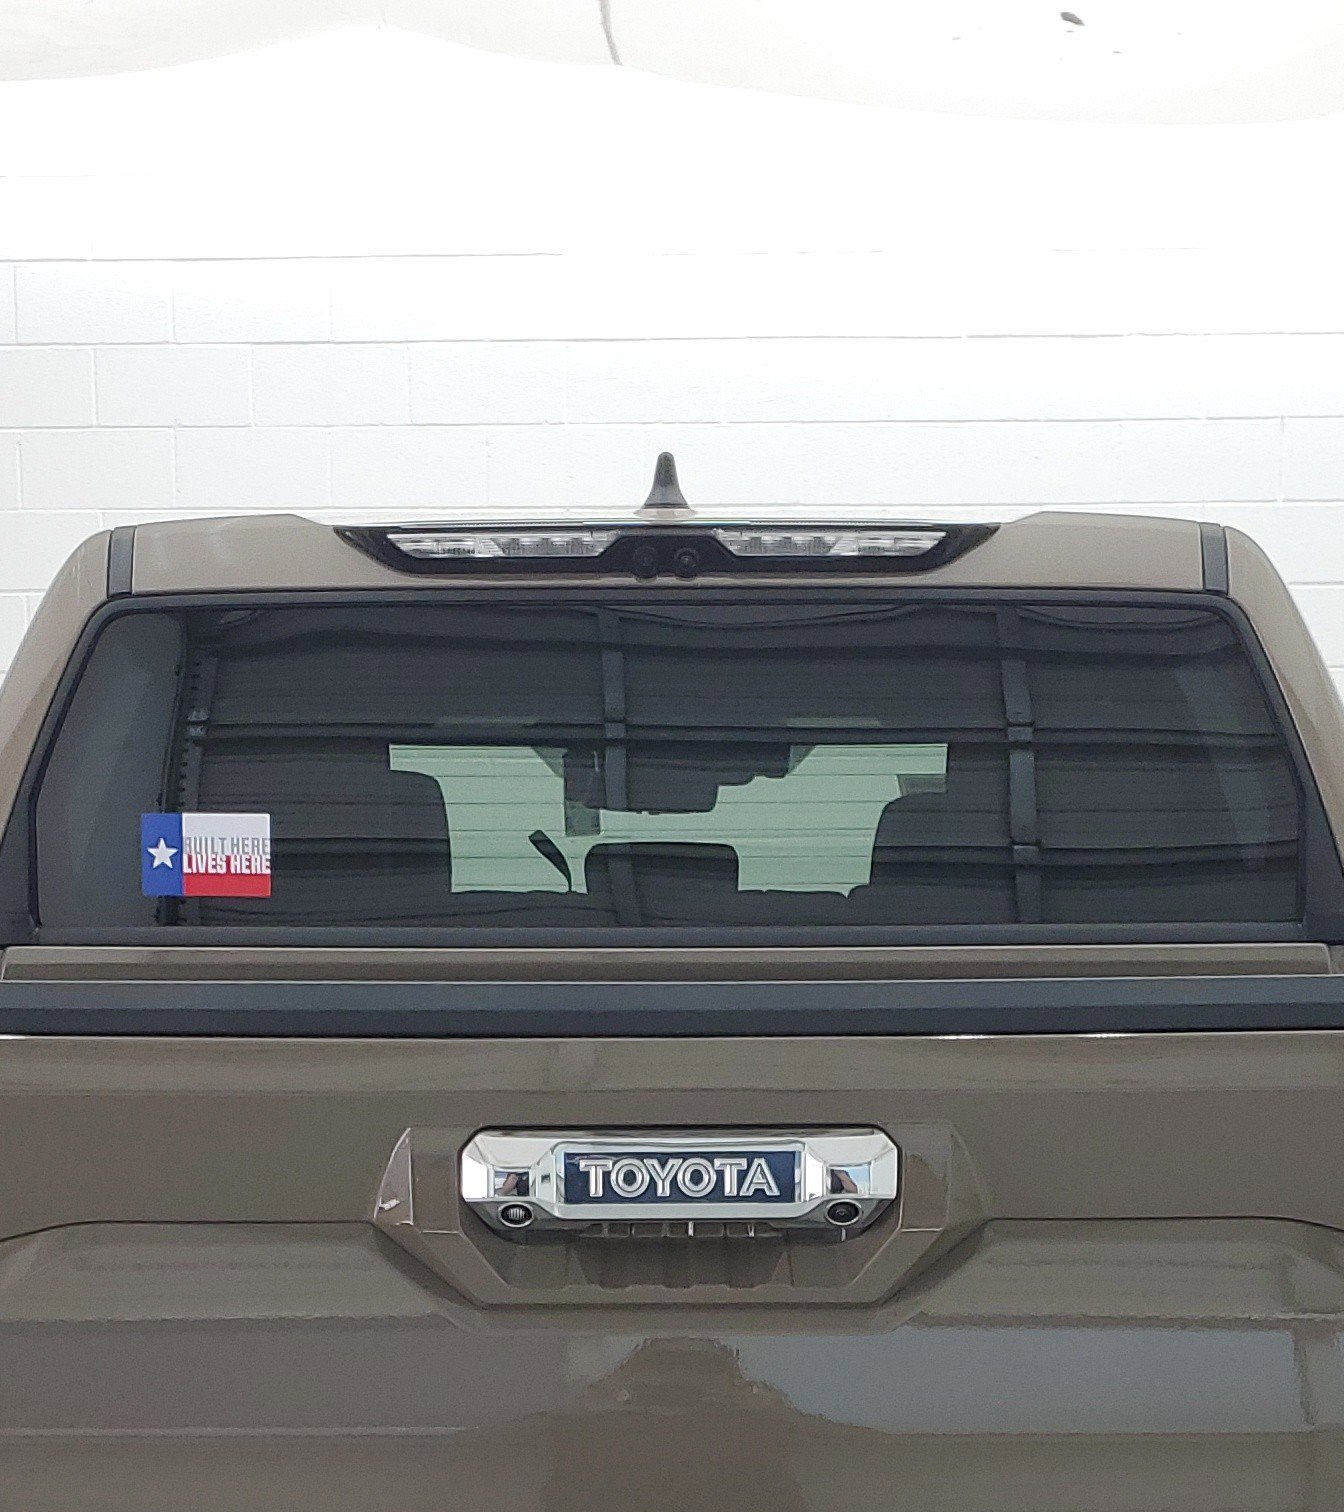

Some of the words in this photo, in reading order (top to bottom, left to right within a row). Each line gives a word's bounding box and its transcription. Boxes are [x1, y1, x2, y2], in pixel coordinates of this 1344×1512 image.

[183, 836, 227, 855] BUILT
[230, 837, 271, 855] HERE
[183, 854, 227, 874] LIVES
[230, 855, 272, 875] HERE
[578, 1157, 781, 1198] TOYOTA
